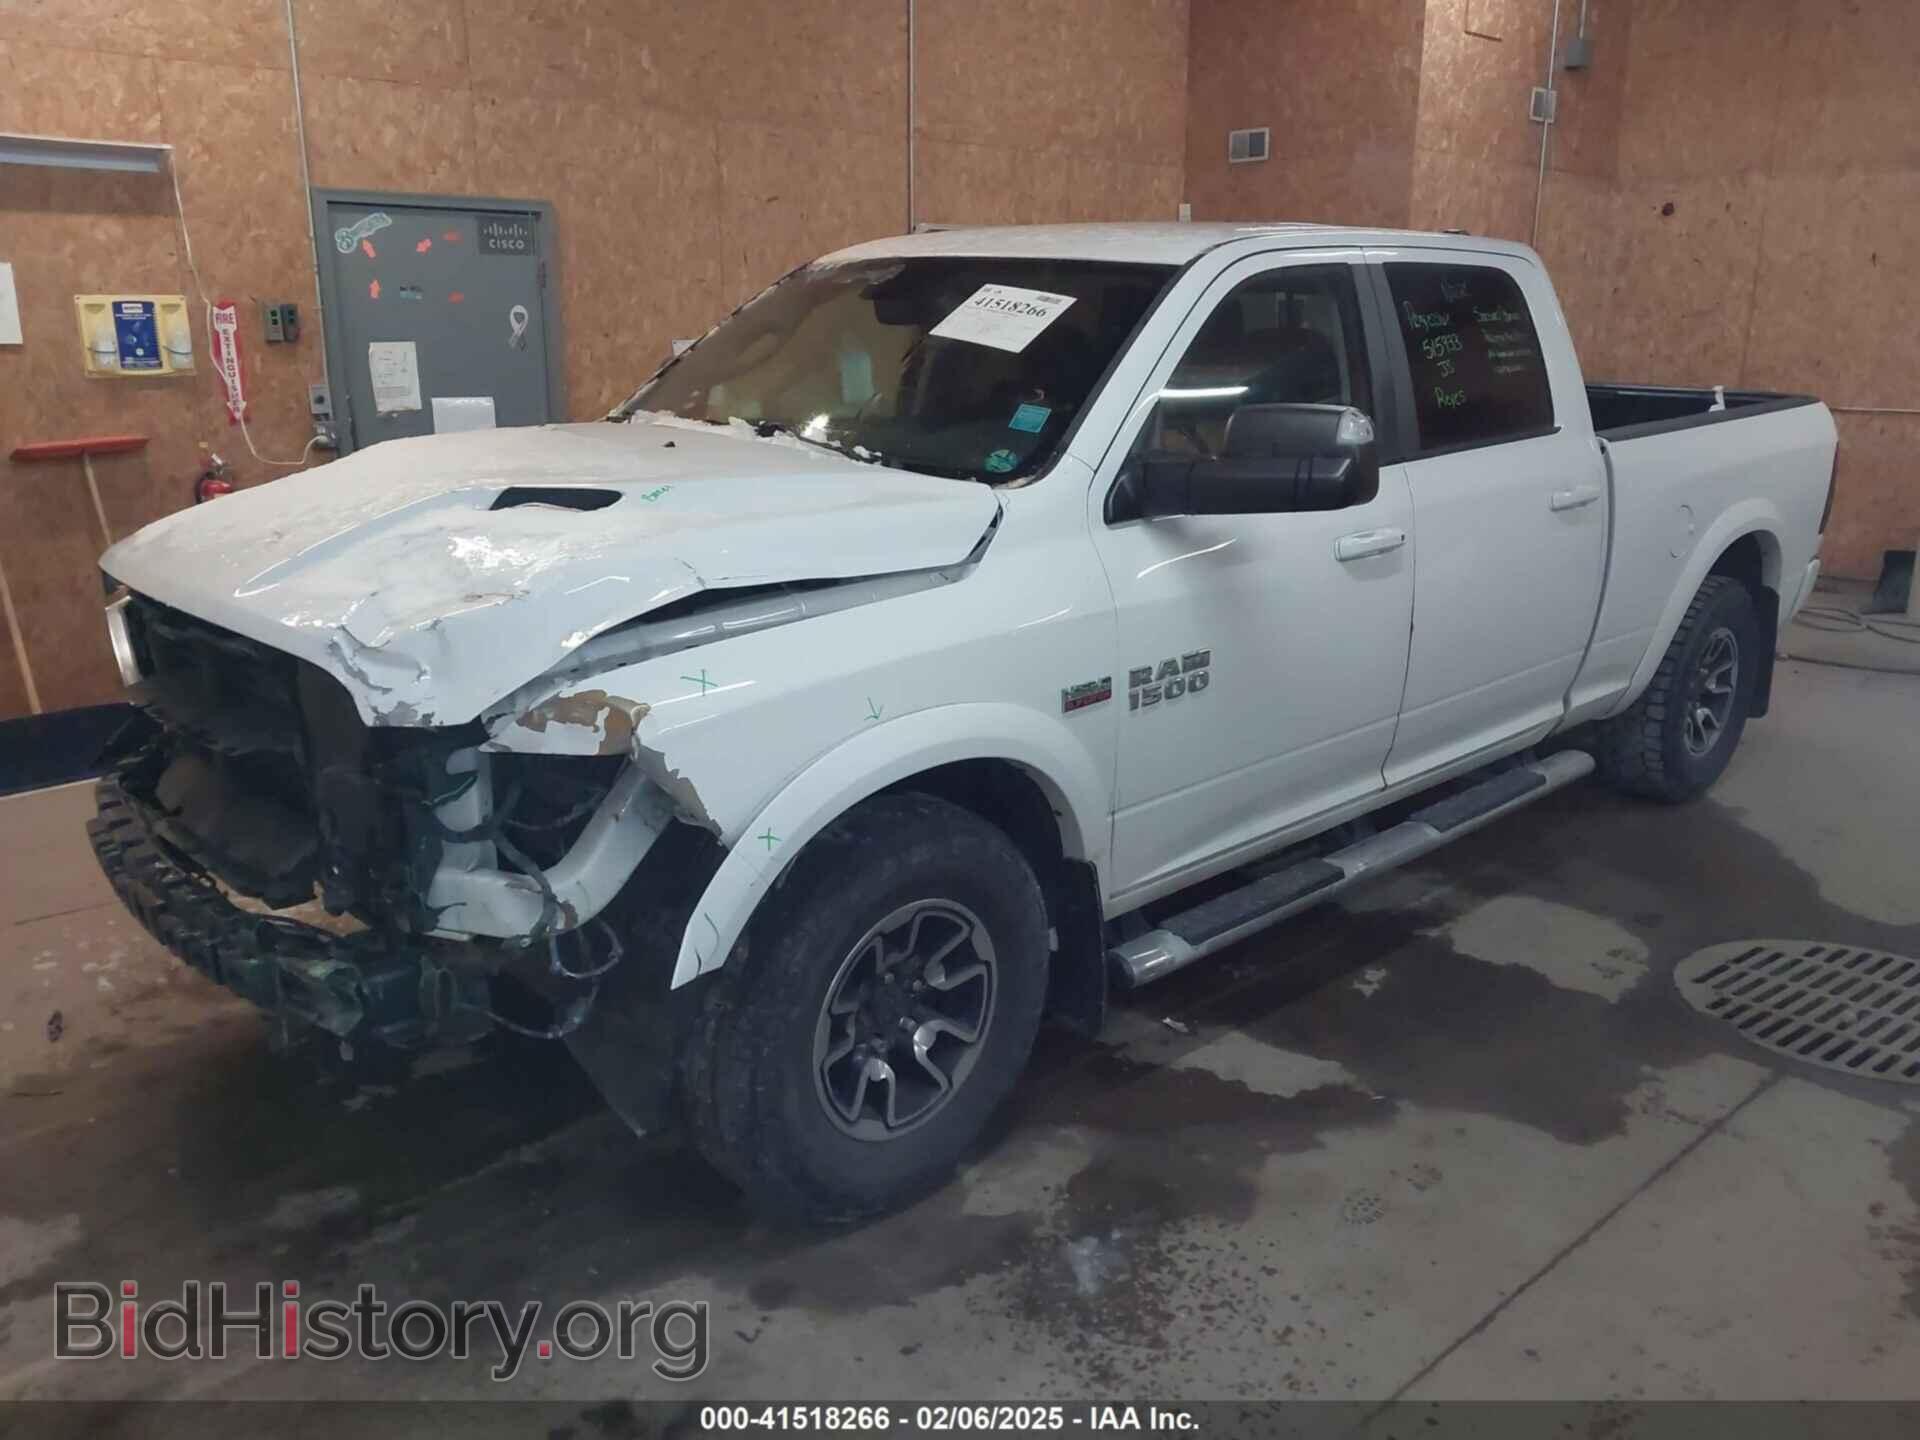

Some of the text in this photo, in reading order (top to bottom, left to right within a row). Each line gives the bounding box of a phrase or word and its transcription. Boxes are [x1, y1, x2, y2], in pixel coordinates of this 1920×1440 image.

[974, 296, 1047, 317] 41518266
[1128, 649, 1211, 689] RAM
[1128, 670, 1210, 711] 1500
